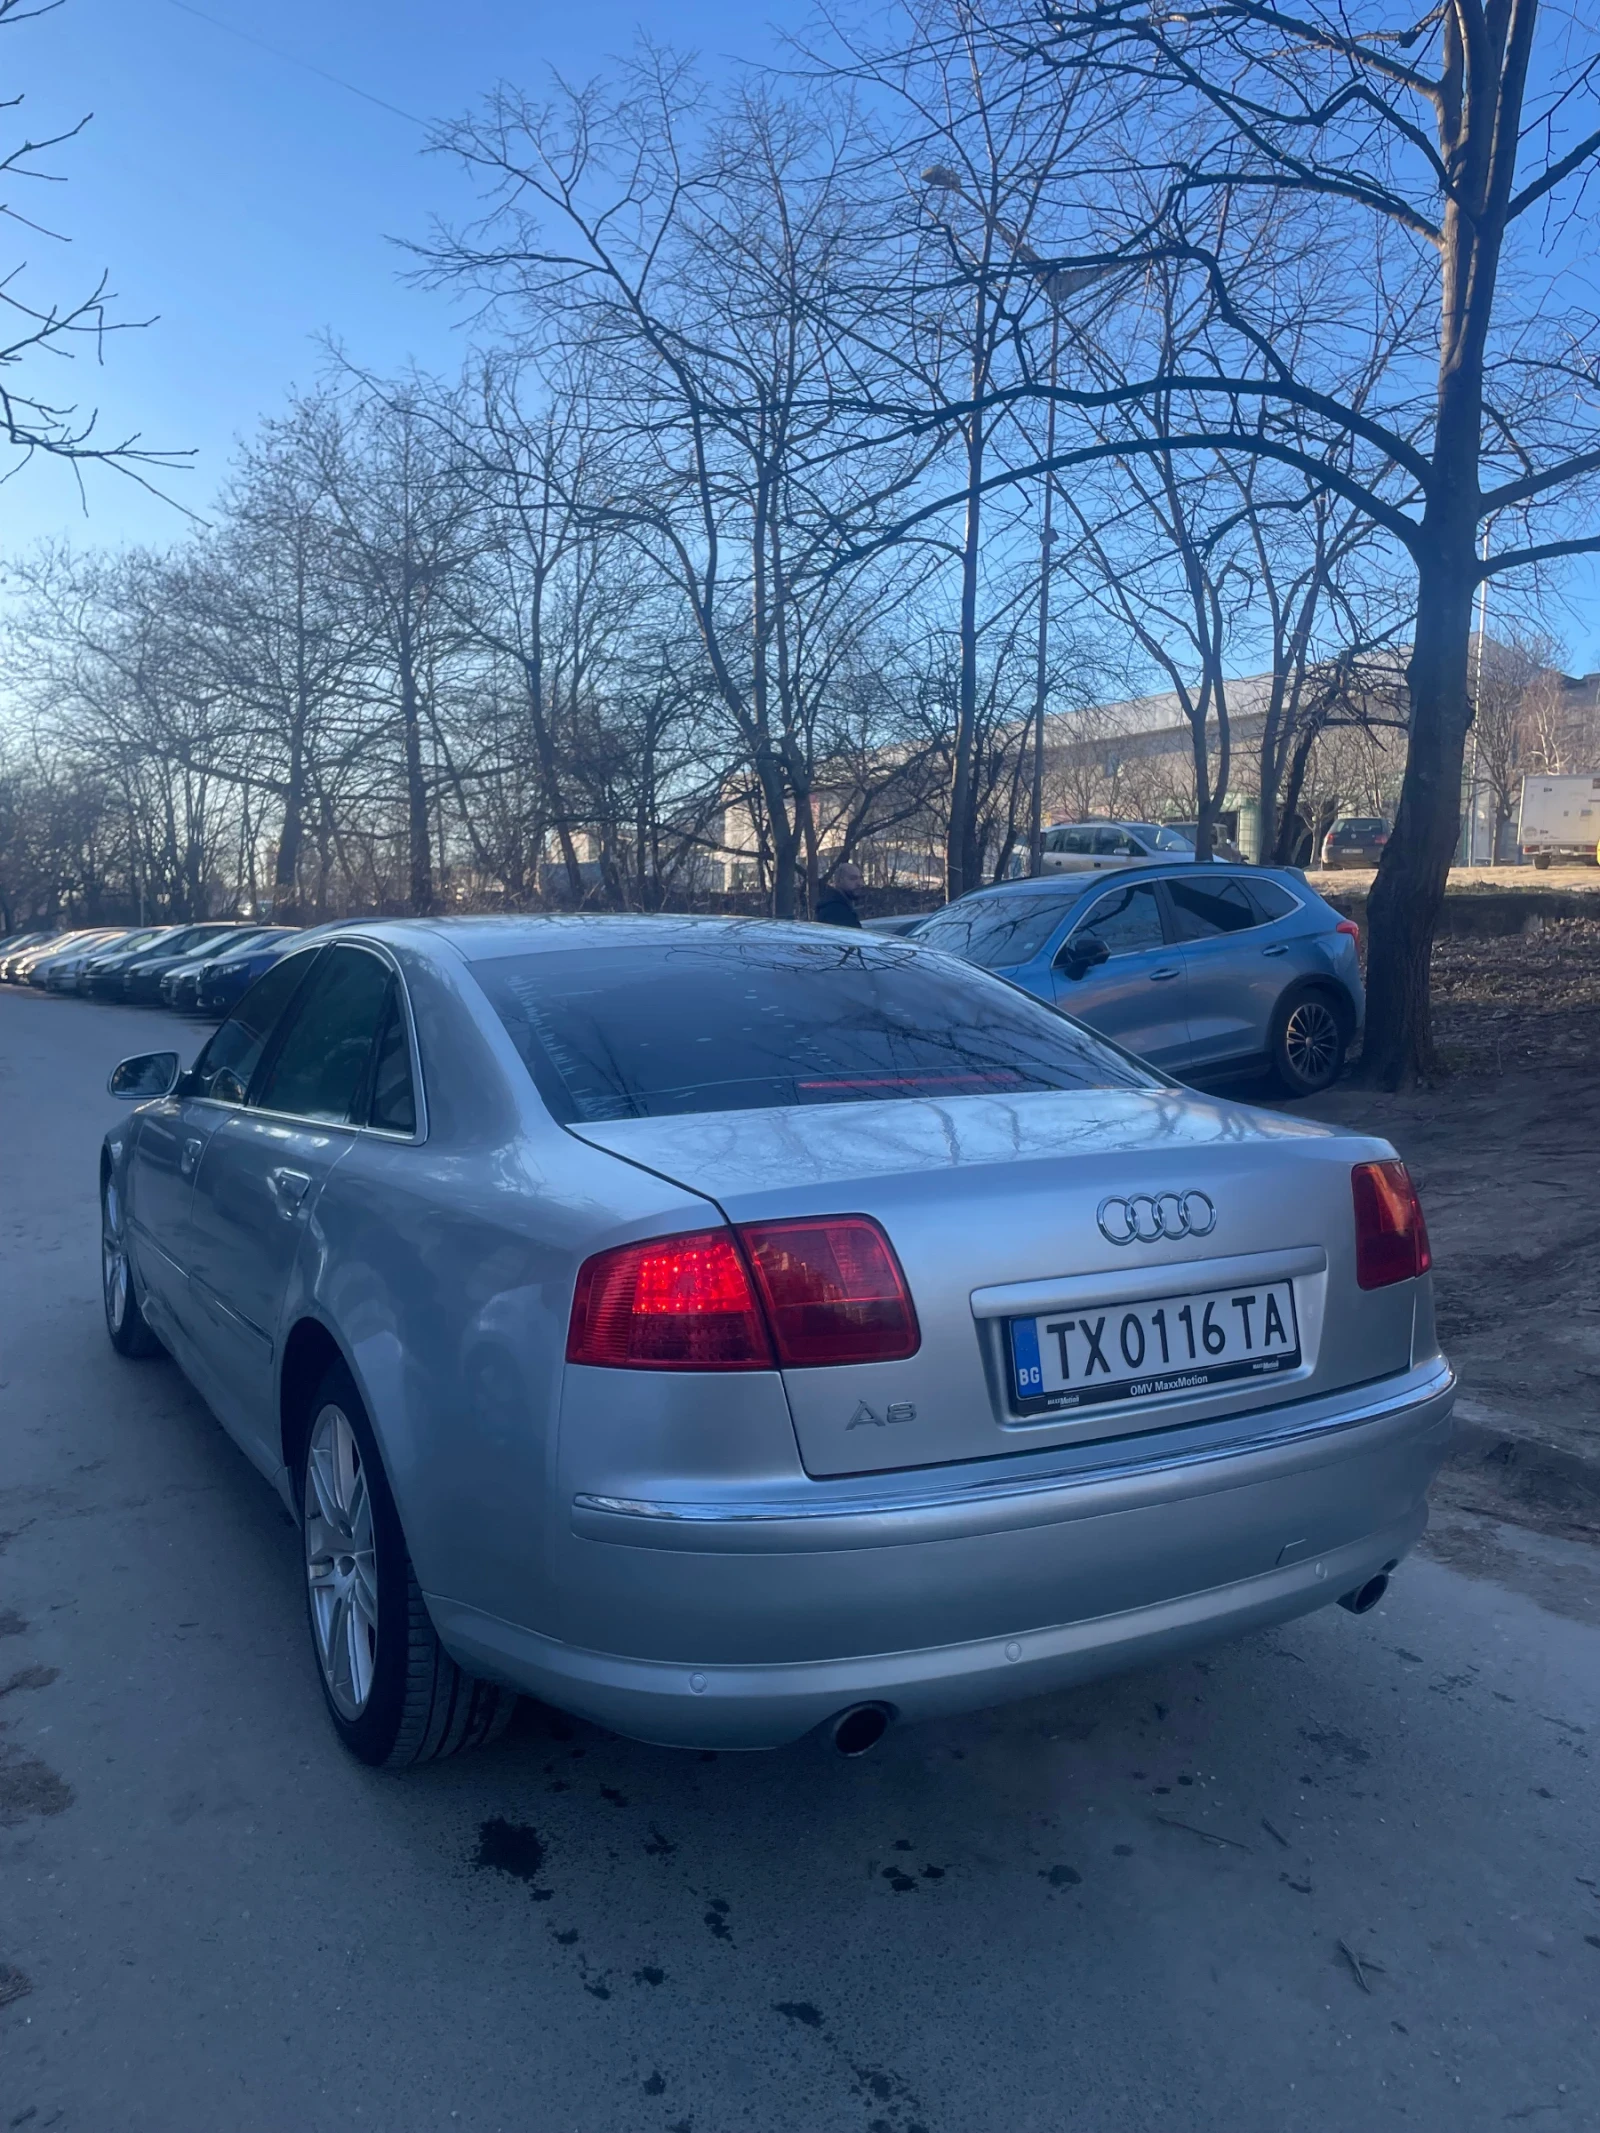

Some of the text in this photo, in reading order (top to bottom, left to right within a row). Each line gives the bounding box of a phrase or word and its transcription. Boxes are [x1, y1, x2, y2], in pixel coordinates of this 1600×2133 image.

[1018, 1367, 1041, 1386] BG
[1130, 1375, 1209, 1396] OMV MaxxMotion
[844, 1399, 918, 1431] A8
